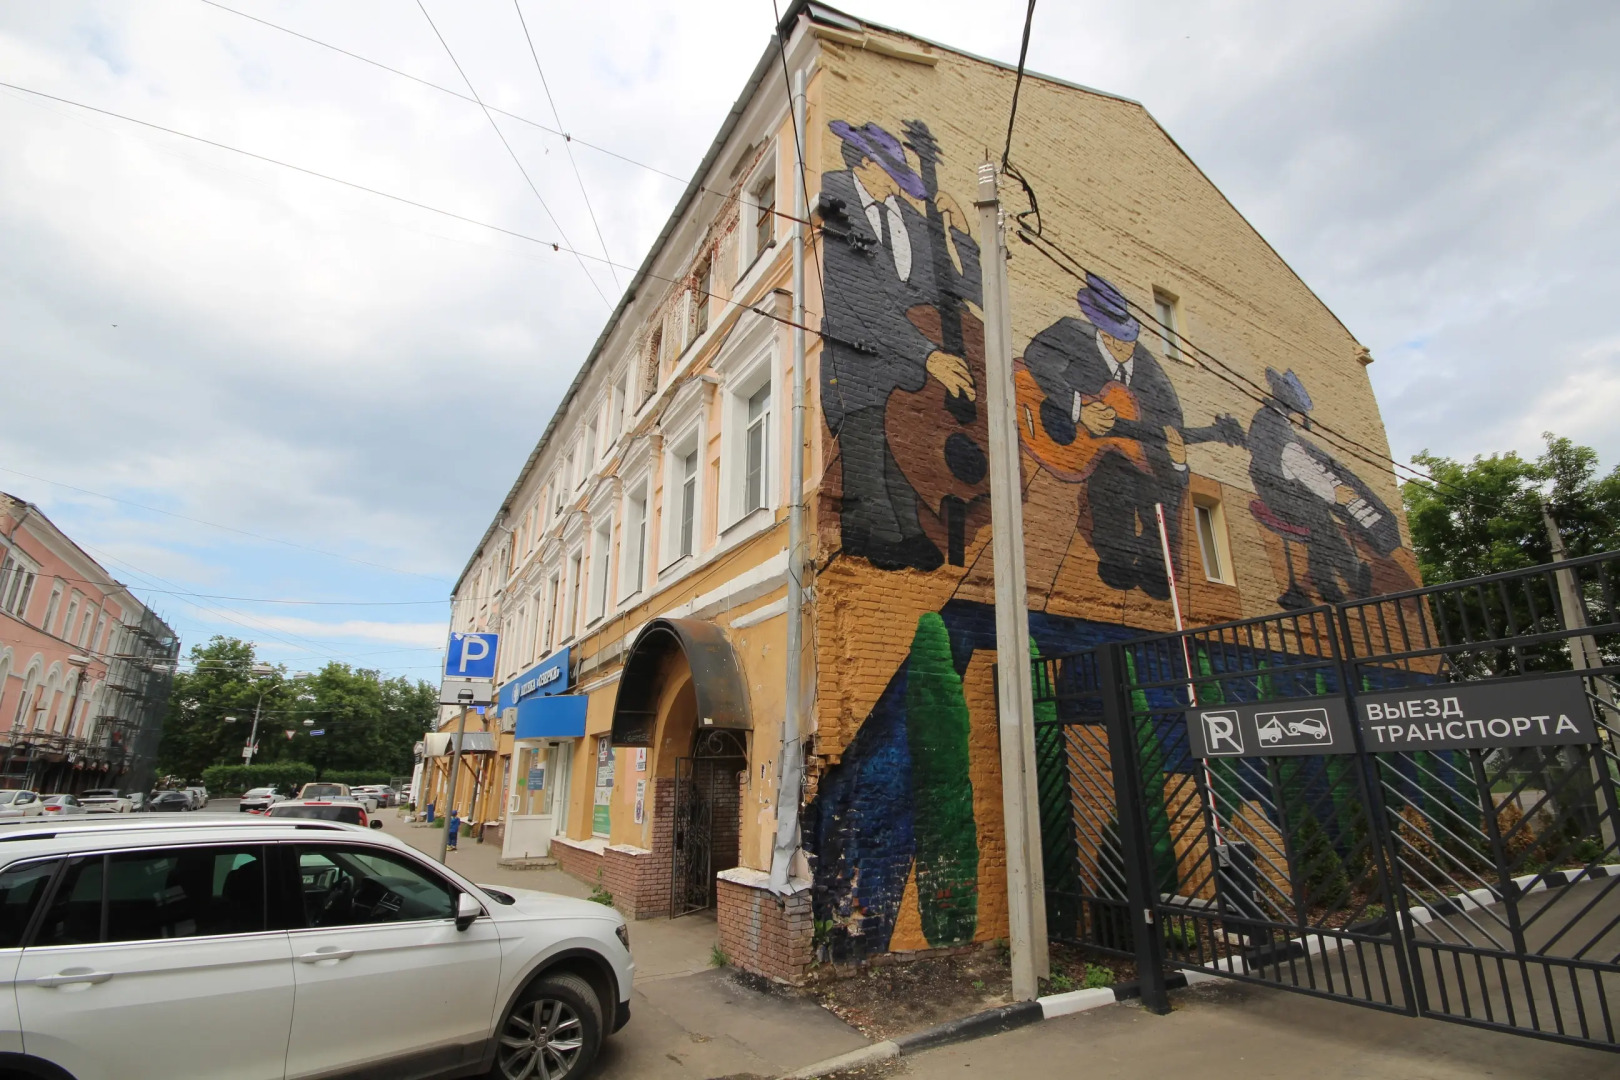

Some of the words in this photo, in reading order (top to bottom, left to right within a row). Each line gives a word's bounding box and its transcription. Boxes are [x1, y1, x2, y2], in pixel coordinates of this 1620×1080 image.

[459, 635, 489, 673] P
[1366, 697, 1464, 722] ВЫЕЗД
[1371, 714, 1580, 744] ТРАНСПОРТА
